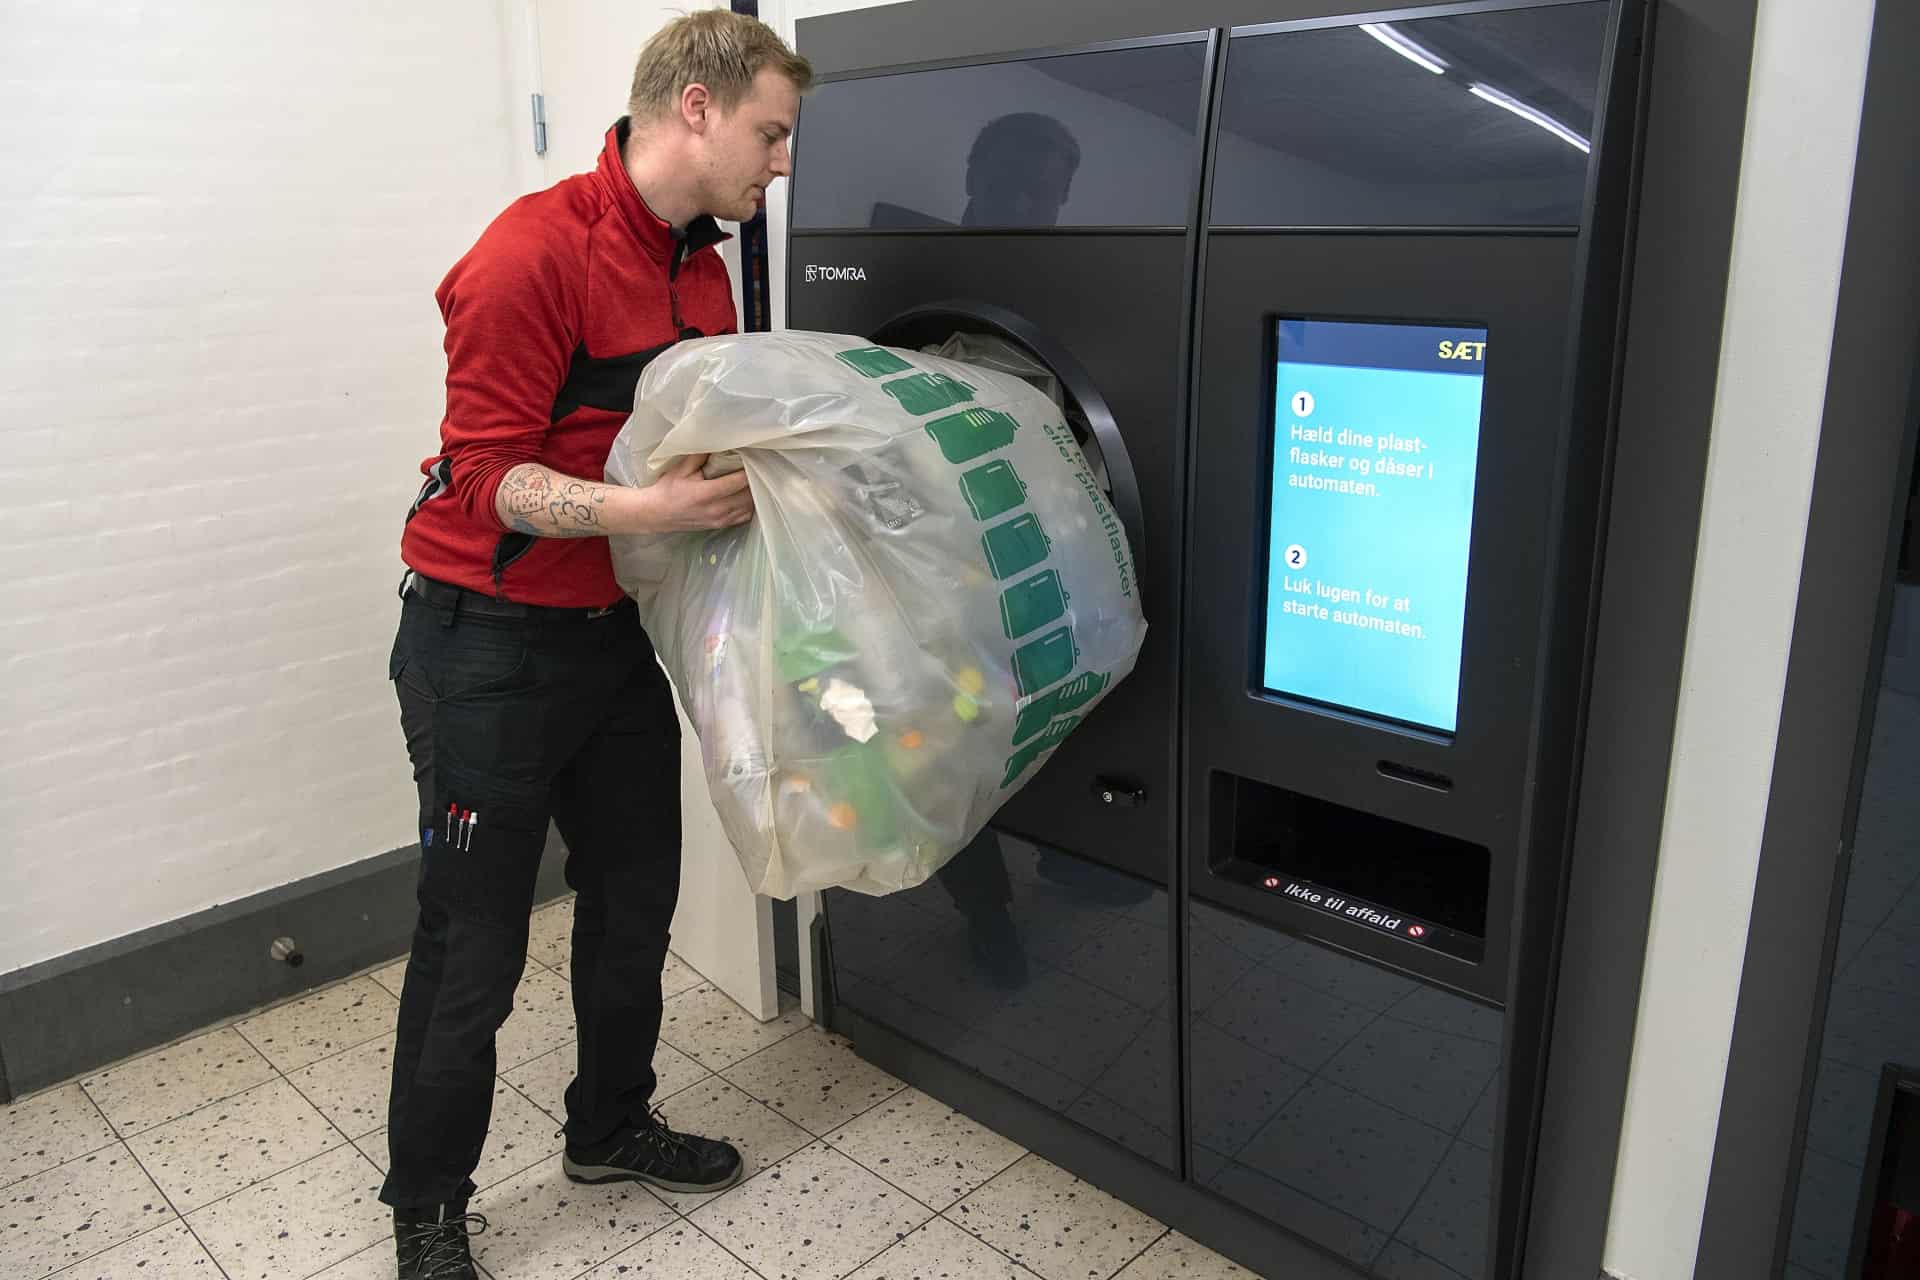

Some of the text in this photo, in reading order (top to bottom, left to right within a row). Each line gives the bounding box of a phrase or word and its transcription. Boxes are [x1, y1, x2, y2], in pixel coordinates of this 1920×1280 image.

[818, 266, 867, 281] TOMRA
[1438, 340, 1487, 361] SÆT
[1290, 423, 1428, 453] Hæld dine plast-
[1289, 447, 1344, 469] flasker
[1349, 457, 1370, 476] og
[1375, 457, 1423, 478] dåser
[1288, 472, 1381, 497] automaten.
[1043, 423, 1074, 464] eller
[1074, 472, 1132, 600] plastflasker
[1284, 575, 1411, 613] Luk lugen for at
[1283, 599, 1427, 640] starte automaten.
[1284, 882, 1402, 930] Ikke til affald
